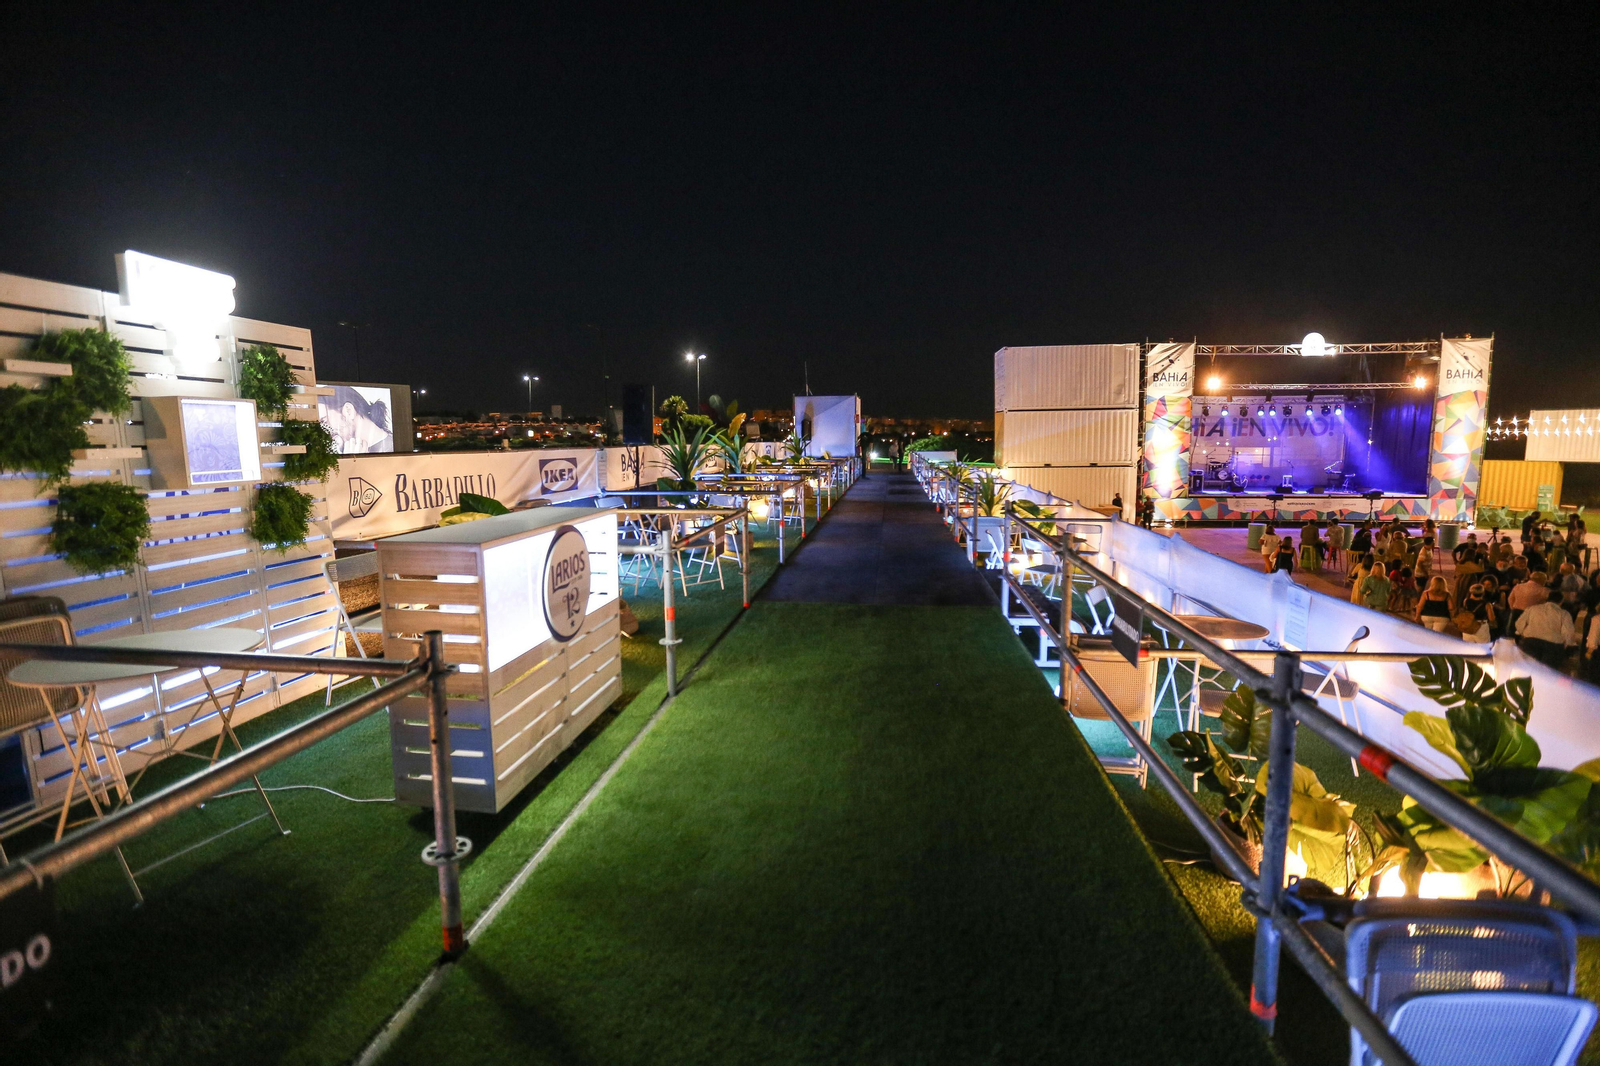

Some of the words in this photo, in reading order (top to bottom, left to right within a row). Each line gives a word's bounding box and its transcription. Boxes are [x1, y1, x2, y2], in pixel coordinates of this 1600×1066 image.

[1271, 417, 1335, 437] VIVO!
[544, 468, 575, 484] IKEA
[551, 551, 586, 594] LARIOS
[562, 587, 581, 620] 12
